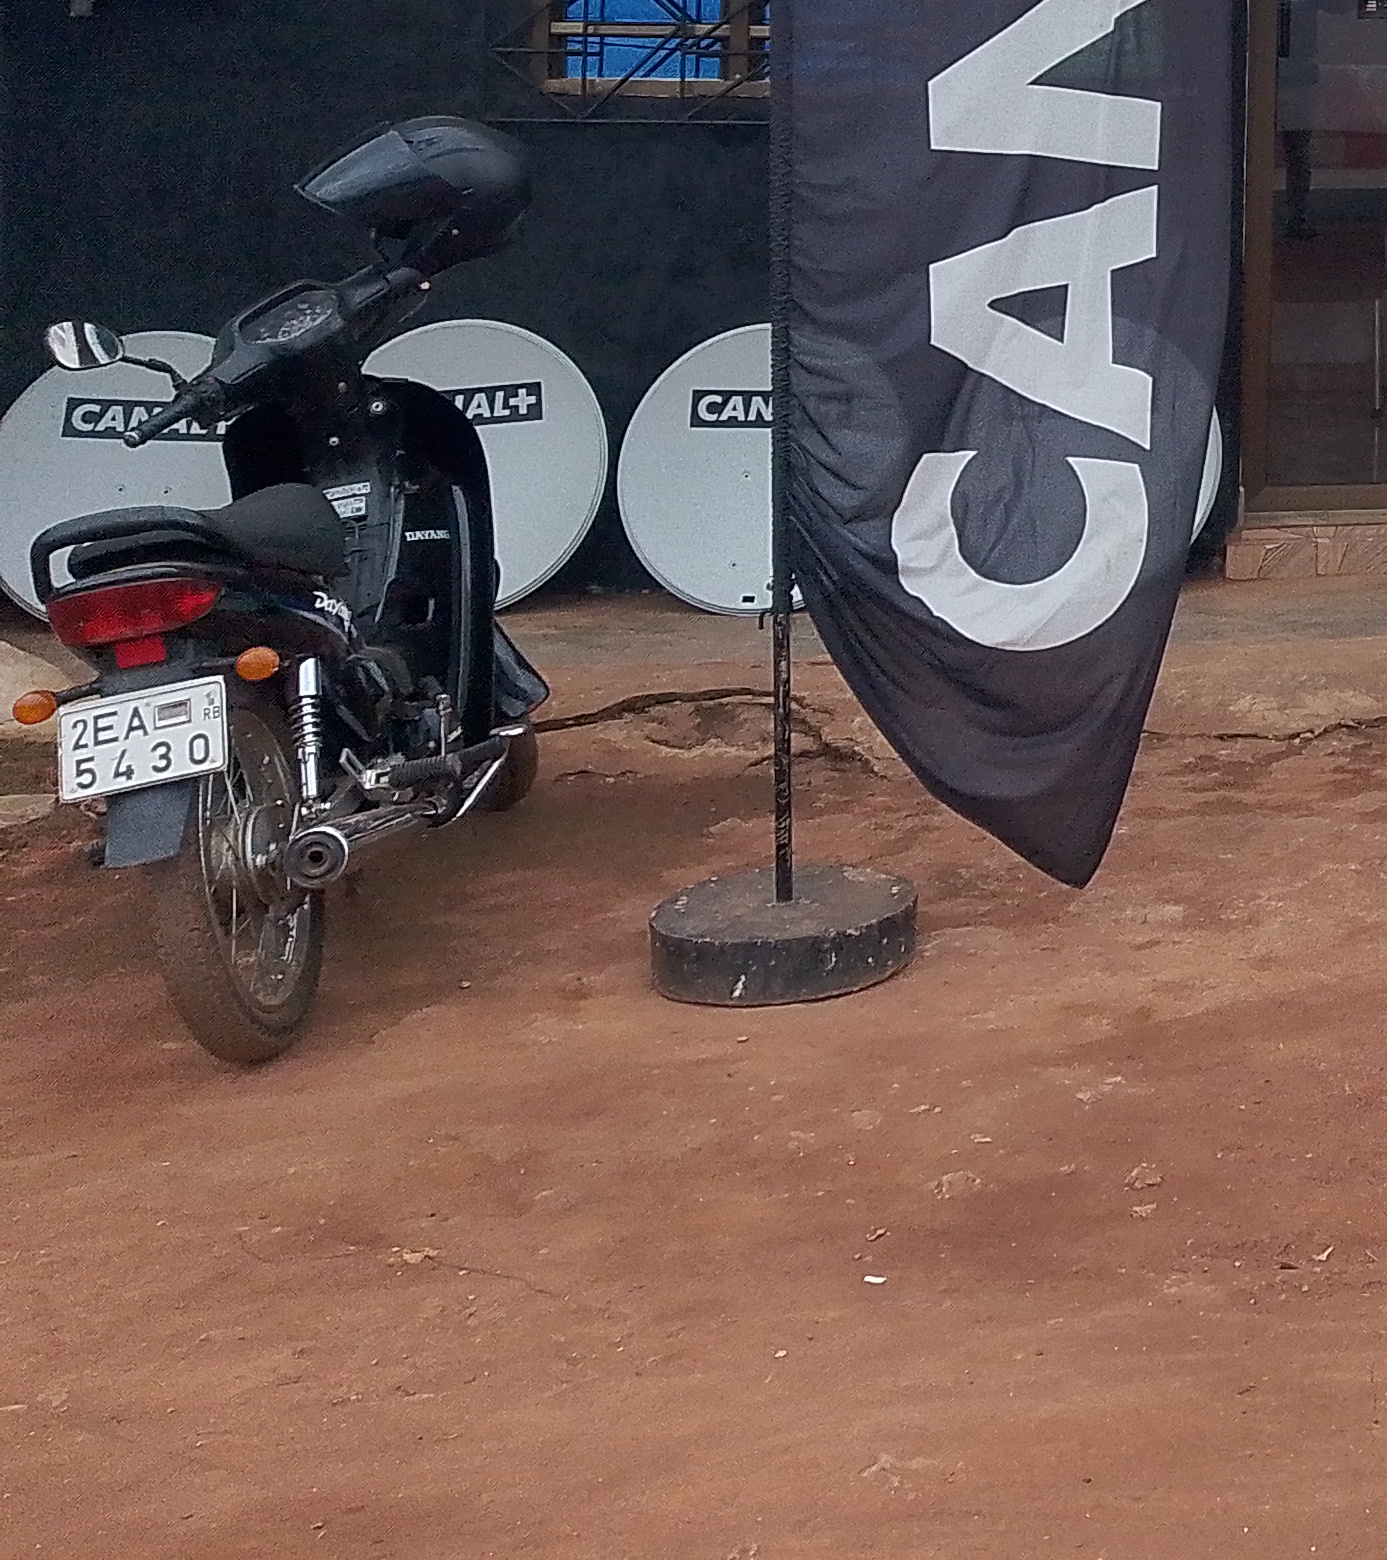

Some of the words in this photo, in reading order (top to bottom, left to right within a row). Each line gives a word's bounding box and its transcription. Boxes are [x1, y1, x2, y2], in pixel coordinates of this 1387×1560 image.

[71, 705, 149, 752] 2EA
[202, 705, 221, 721] RB
[74, 732, 211, 790] 5430
